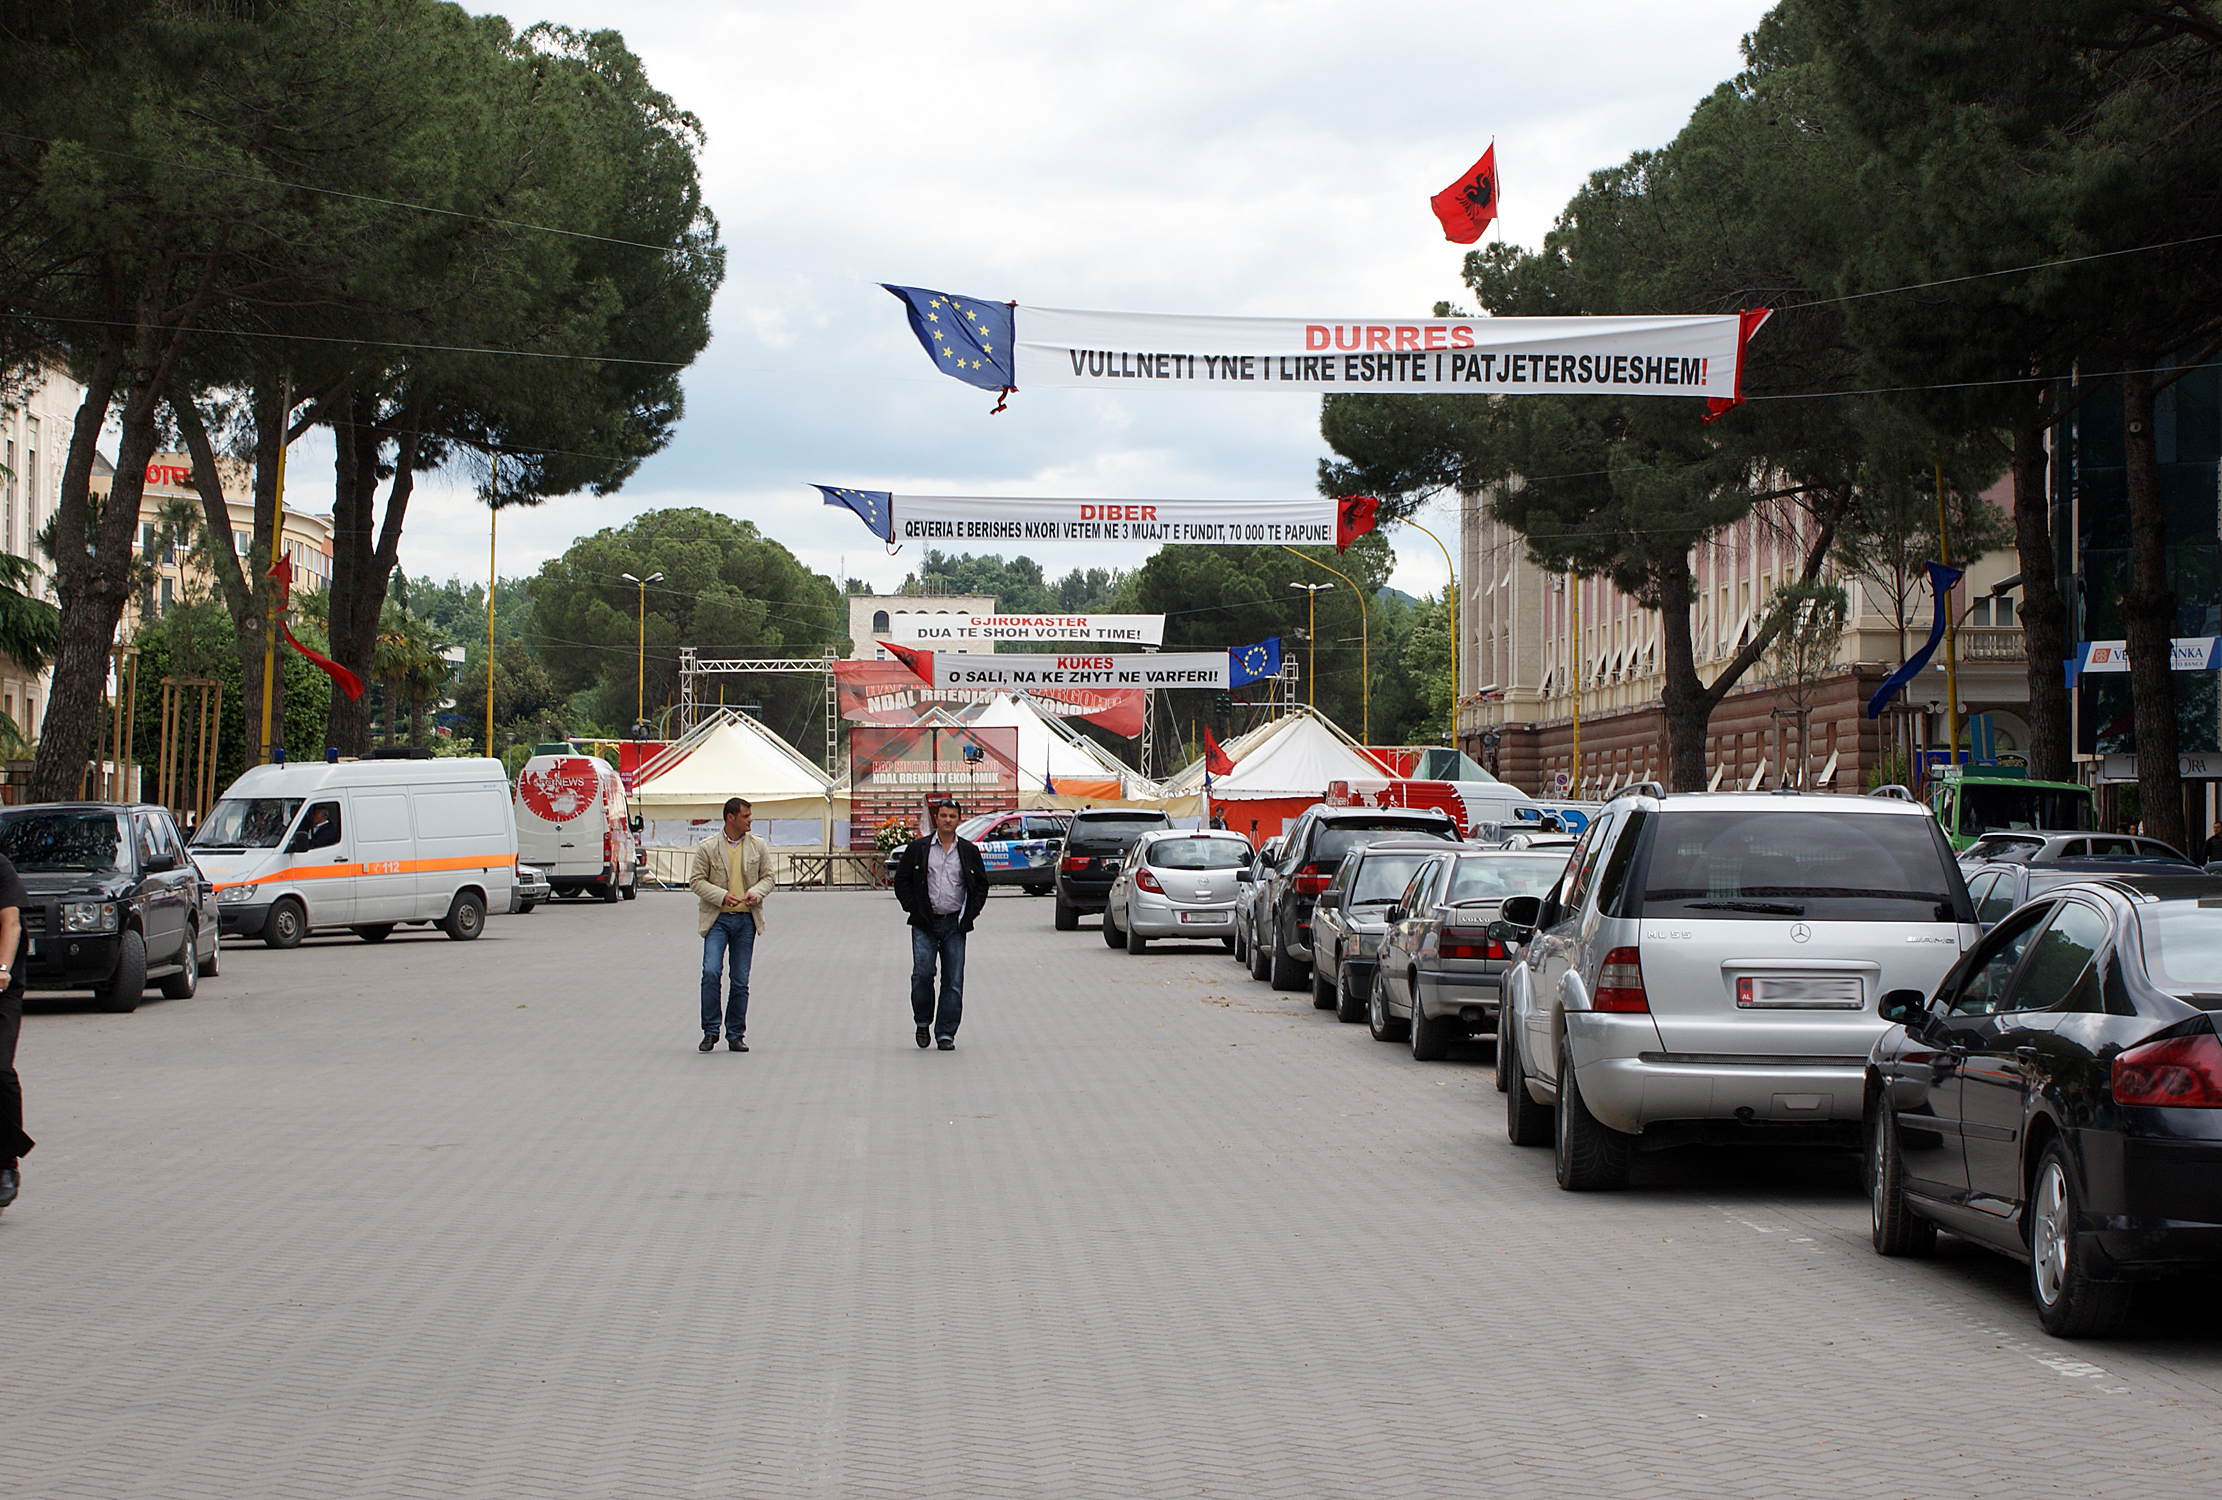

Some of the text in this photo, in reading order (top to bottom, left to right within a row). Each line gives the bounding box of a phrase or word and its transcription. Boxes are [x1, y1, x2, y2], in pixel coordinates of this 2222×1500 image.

[1305, 325, 1475, 351] DURRES
[1069, 349, 1708, 386] VULLNETI YNE I LIRE ESHTE I PATJETERSUESHEM!
[145, 464, 191, 486] OTEL
[1080, 505, 1157, 521] DIBER
[905, 521, 1332, 543] QEVERIA E BERISHES NXORI VETEM NE 3 MUAJT E FUNDIT, 70 000 TE PAPUNE!
[970, 617, 1088, 627] GJIROKASTER
[917, 628, 1142, 640] DUA TE SHOH VOTEN TIME!
[2170, 647, 2204, 659] ANKA
[1057, 657, 1114, 669] KUKES
[949, 670, 1219, 685] O SALI, NA KE ZHYT NE VARFERI!
[867, 690, 917, 714] NDAL
[872, 761, 893, 773] HAP
[554, 777, 585, 787] NEWS
[872, 772, 999, 785] NDAL RRENIMIT EKONOMIK
[382, 861, 400, 873] 112
[1647, 930, 1692, 939] ML 55
